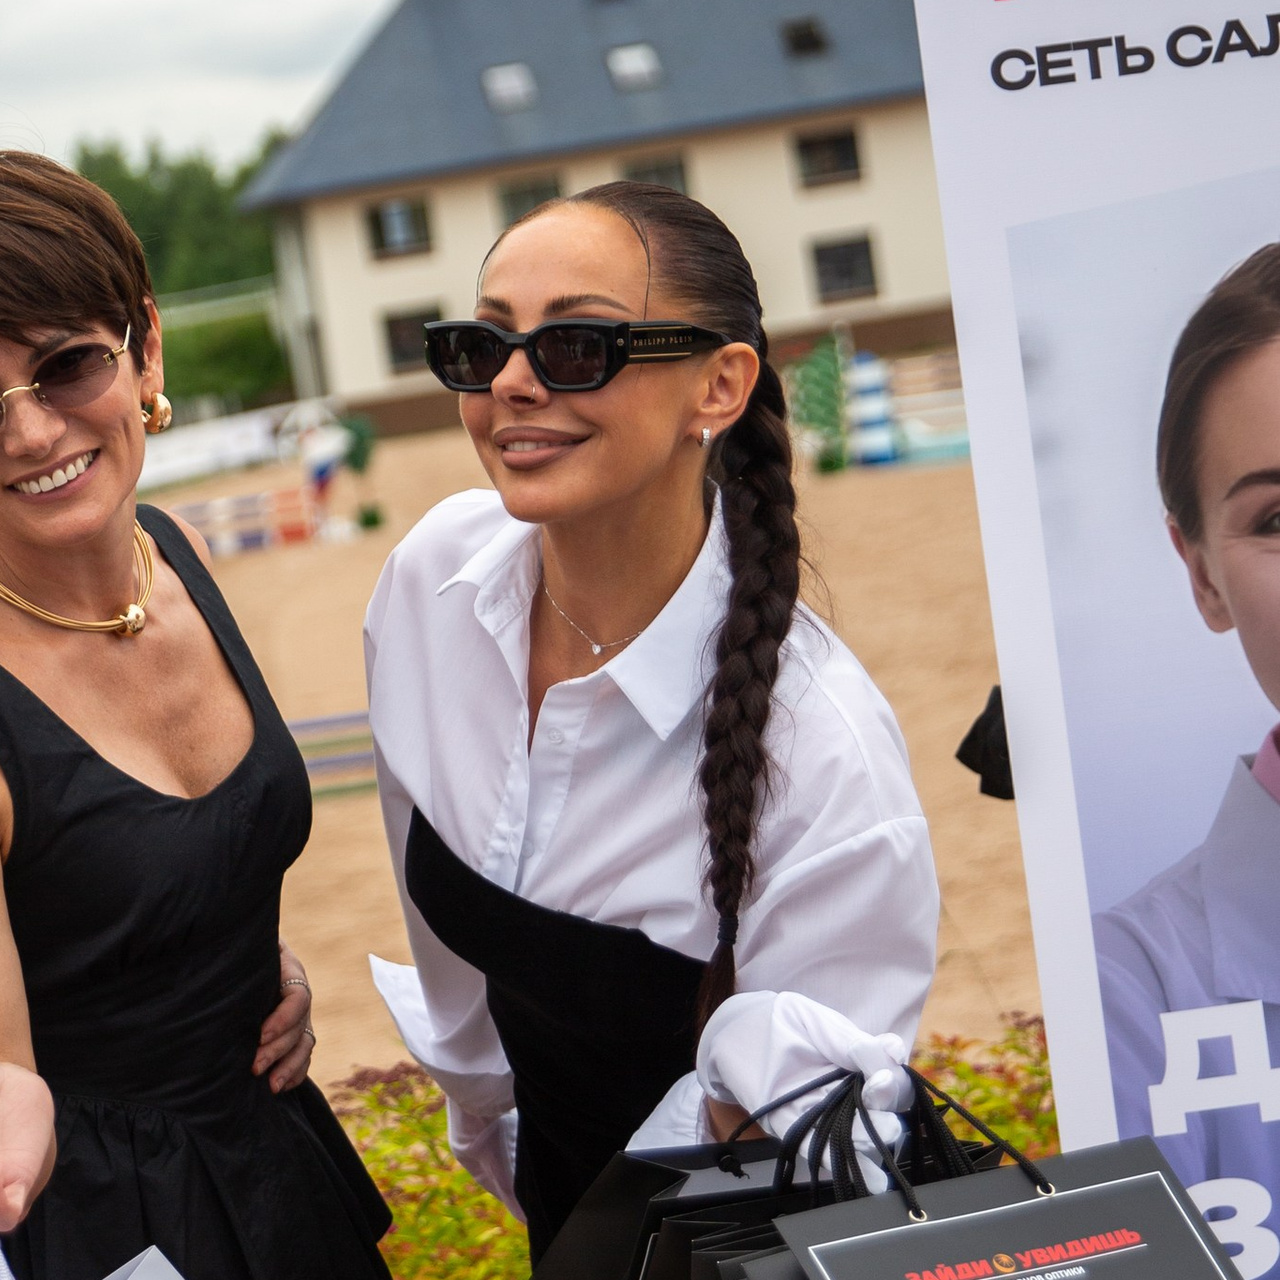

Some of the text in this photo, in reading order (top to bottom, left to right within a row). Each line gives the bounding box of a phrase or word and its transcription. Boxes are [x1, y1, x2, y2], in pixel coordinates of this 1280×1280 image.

[991, 35, 1155, 91] СЕТЬ
[633, 335, 693, 346] PHILIPP PLEIN
[1014, 1227, 1143, 1269] УВИДИШЬ
